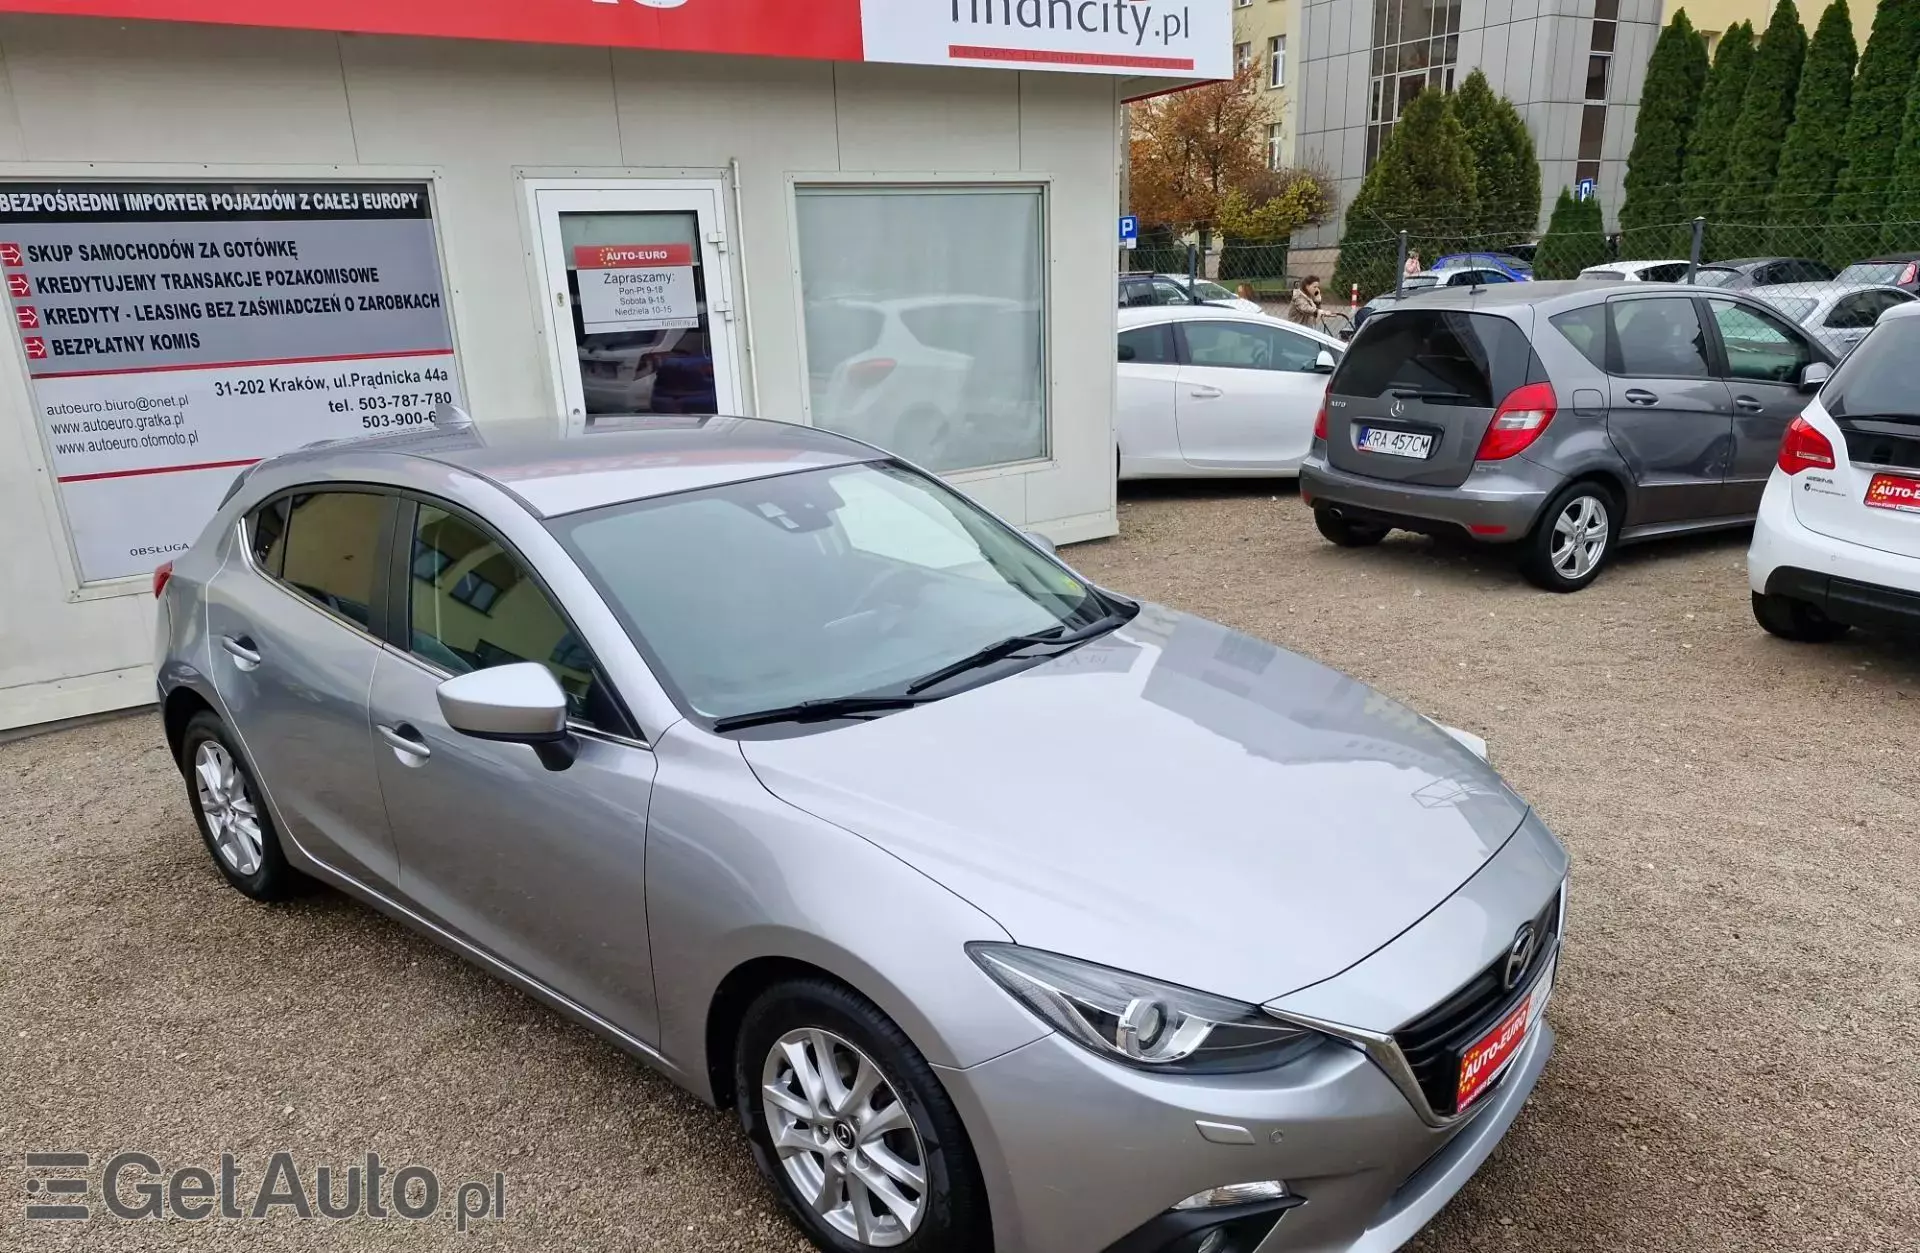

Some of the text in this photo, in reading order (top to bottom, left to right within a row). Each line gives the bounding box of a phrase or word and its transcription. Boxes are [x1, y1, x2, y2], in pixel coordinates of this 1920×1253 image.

[0, 189, 418, 212] BEZPOŚREDNI IMPORTER POJAZDÓW Z CAŁEJ EUROPY
[1122, 219, 1133, 236] P
[27, 238, 298, 262] SKUP SAMOCHODÓW ZA GOTÓWKĘ
[606, 251, 668, 261] AUTO-EURO
[35, 267, 380, 294] KREDYTUJEMY TRANSAKCJE POZAKOMISOWE
[603, 272, 675, 286] Zapraszamy:
[619, 286, 663, 295] Pon-Pt 9-18
[43, 306, 120, 325] KREDYTY
[134, 302, 202, 322] LEASING
[205, 300, 236, 319] BEZ
[238, 294, 341, 317] ZAŚWIADCZEŃ
[345, 296, 355, 312] O
[358, 293, 440, 311] ZAROBKACH
[615, 306, 672, 316] Niedziela 10-15
[620, 296, 665, 306] Sobota 9-15
[52, 332, 200, 356] BEZPŁATNY KOMIS
[214, 368, 448, 397] 31-202 Kraków, ul.Prądnicka 44a
[46, 394, 190, 416] autoeuro.biuro@onet.pl
[328, 391, 452, 412] tel. 503-787-780
[50, 412, 185, 435] www.autoeuro.gratka.pl
[56, 430, 199, 455] www.autoeuro.otomoto.pl
[1365, 430, 1431, 453] KRA 457CM
[129, 543, 190, 556] OBSŁUGA
[1464, 1010, 1527, 1083] AUTO-EURO
